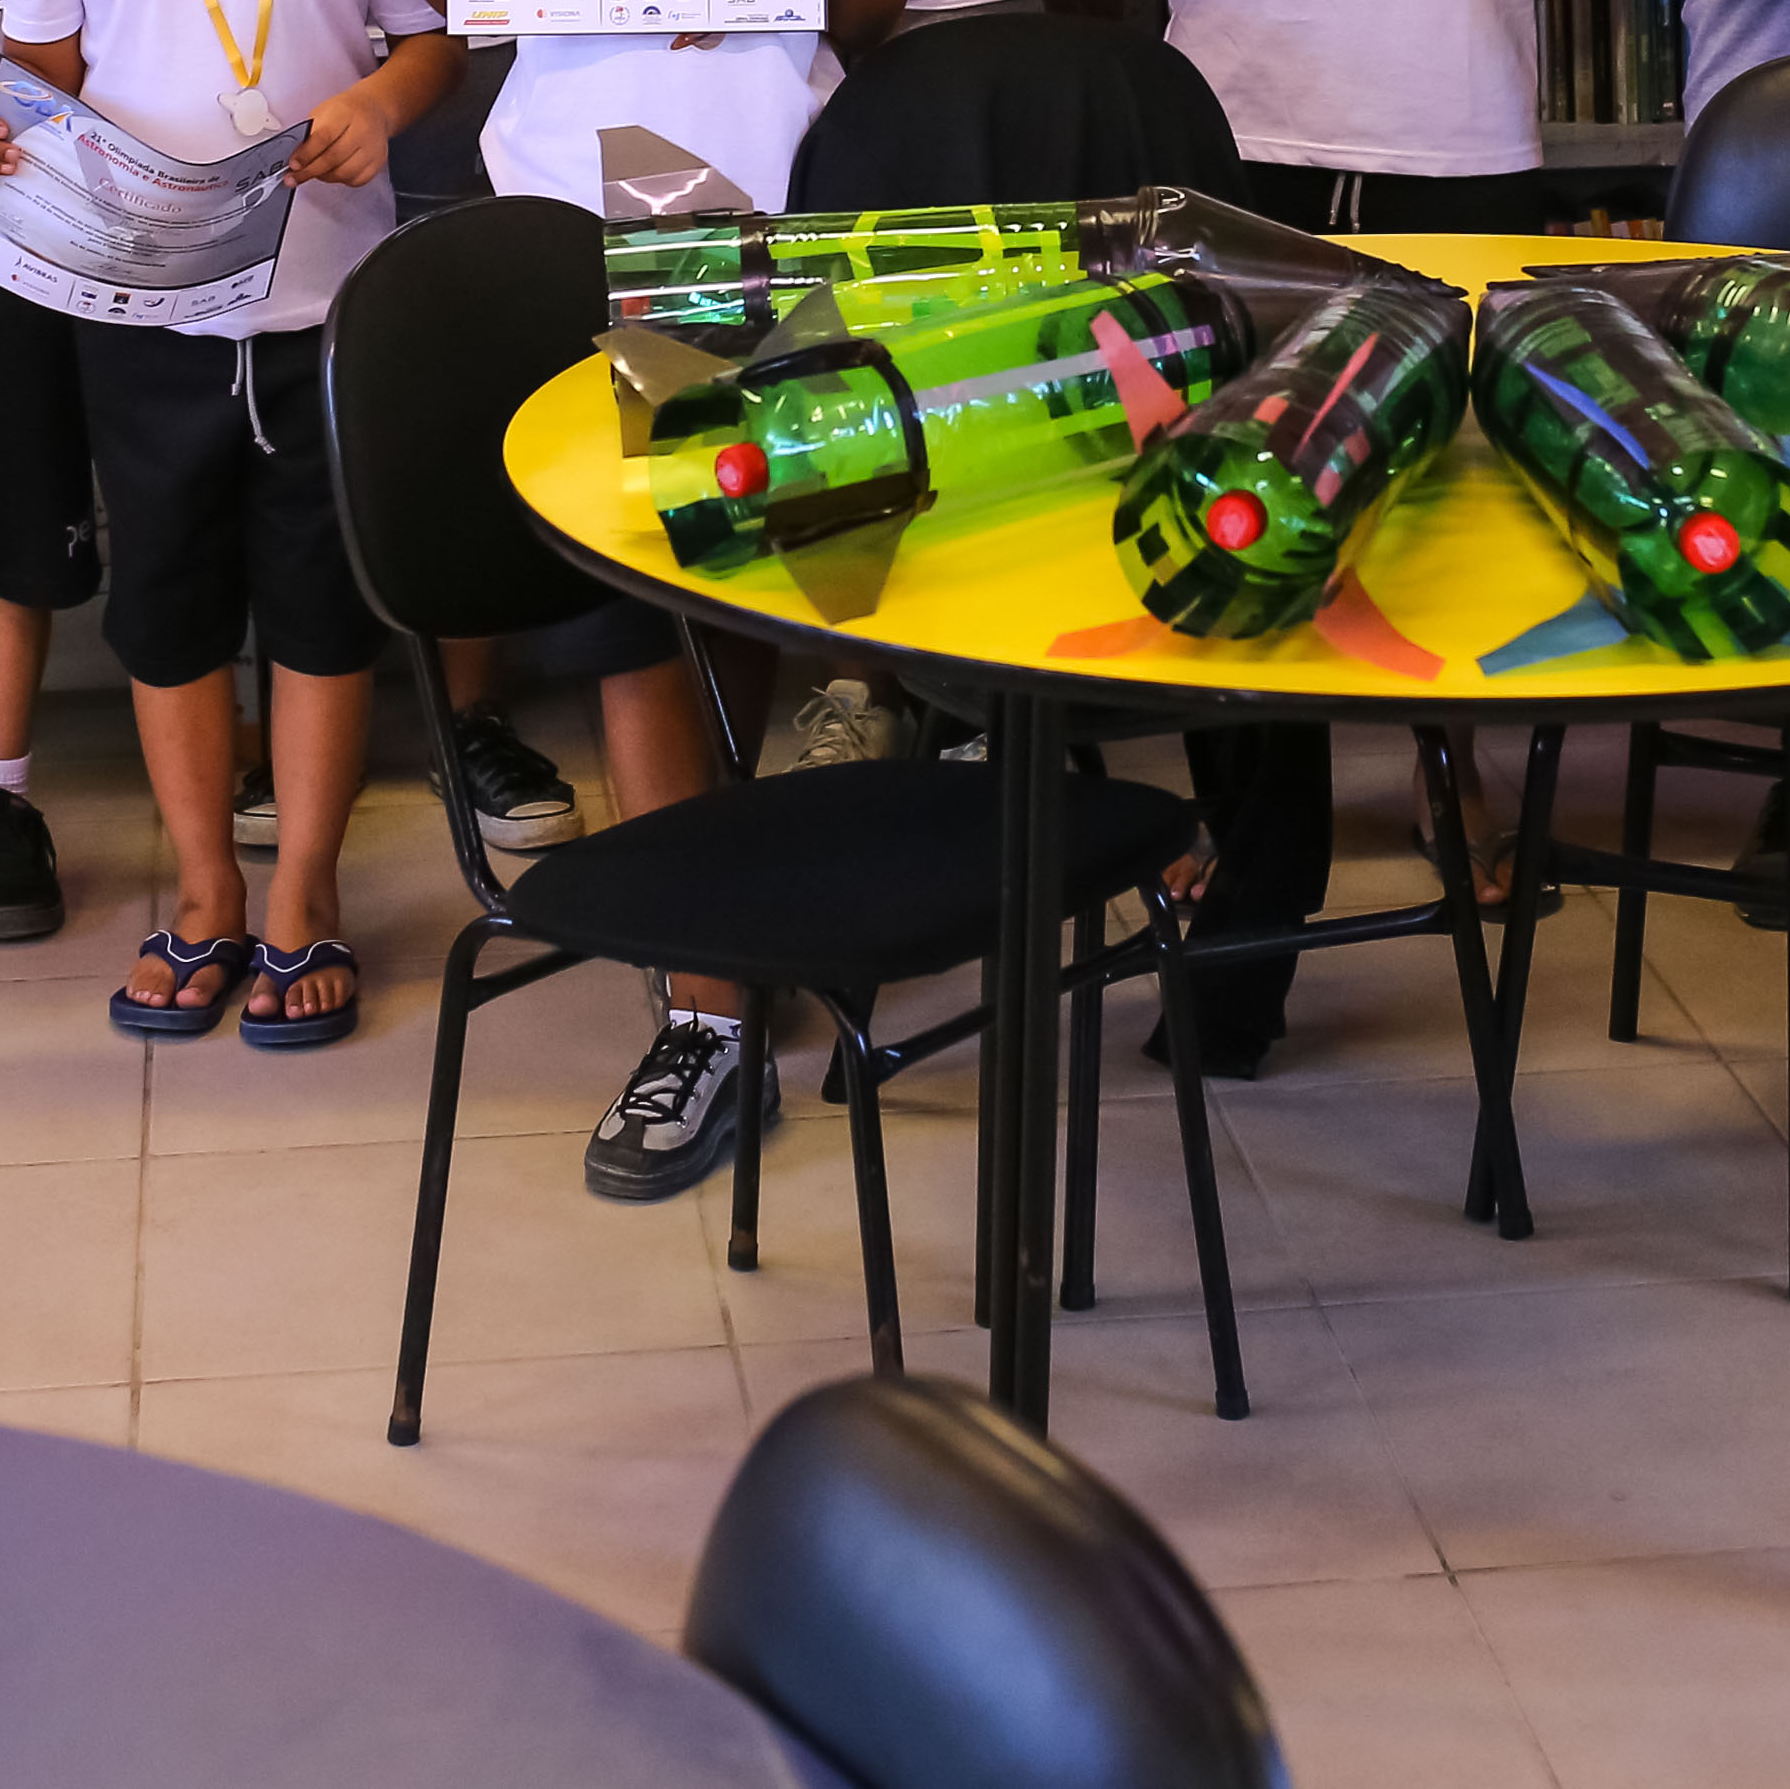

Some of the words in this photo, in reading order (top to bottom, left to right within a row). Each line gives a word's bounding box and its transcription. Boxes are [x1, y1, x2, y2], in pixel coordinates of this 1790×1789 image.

[77, 133, 140, 179] Astronomia
[107, 141, 156, 175] Olimpíada
[234, 160, 285, 194] SAB
[99, 176, 182, 215] Certificado
